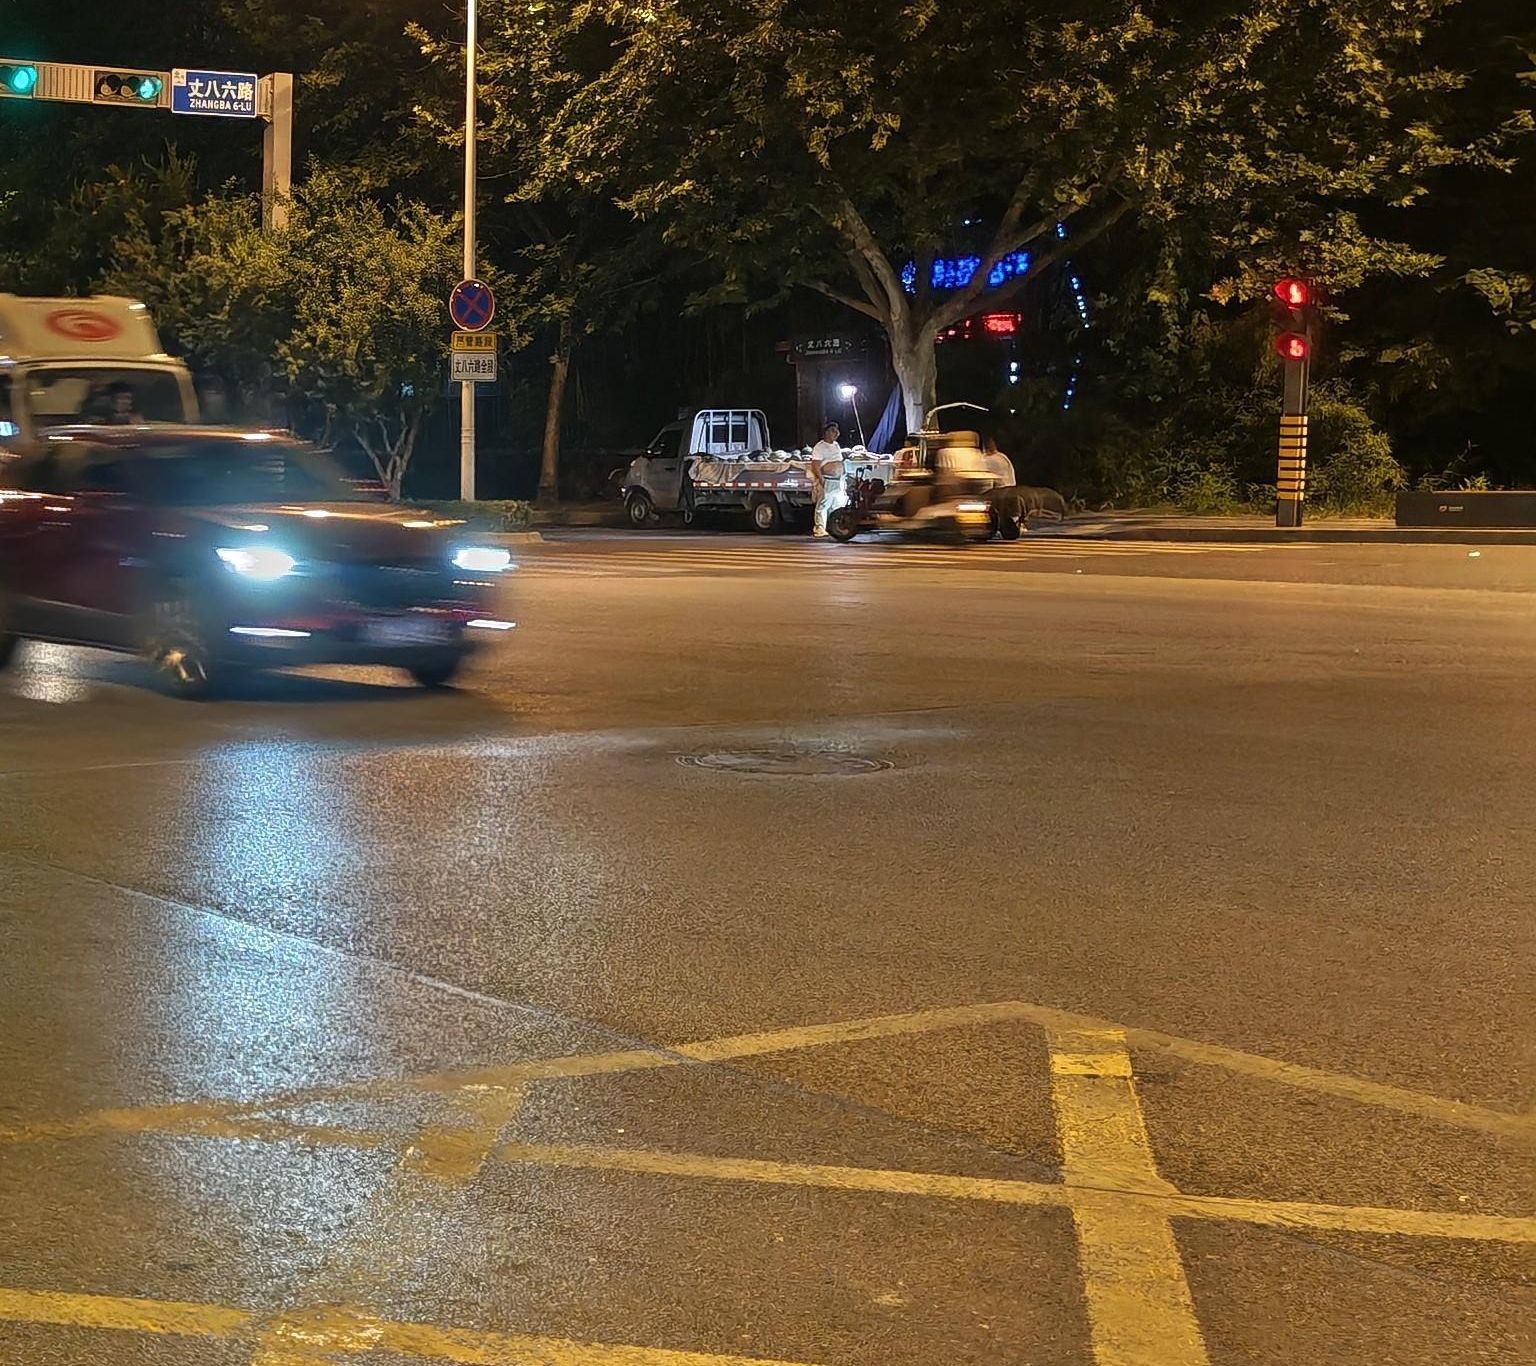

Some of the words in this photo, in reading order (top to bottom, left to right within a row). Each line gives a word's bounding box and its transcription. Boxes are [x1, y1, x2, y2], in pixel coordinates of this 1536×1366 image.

[188, 78, 254, 101] 丈八六路
[189, 98, 231, 111] ZHANGBA
[232, 101, 252, 111] 6-LU
